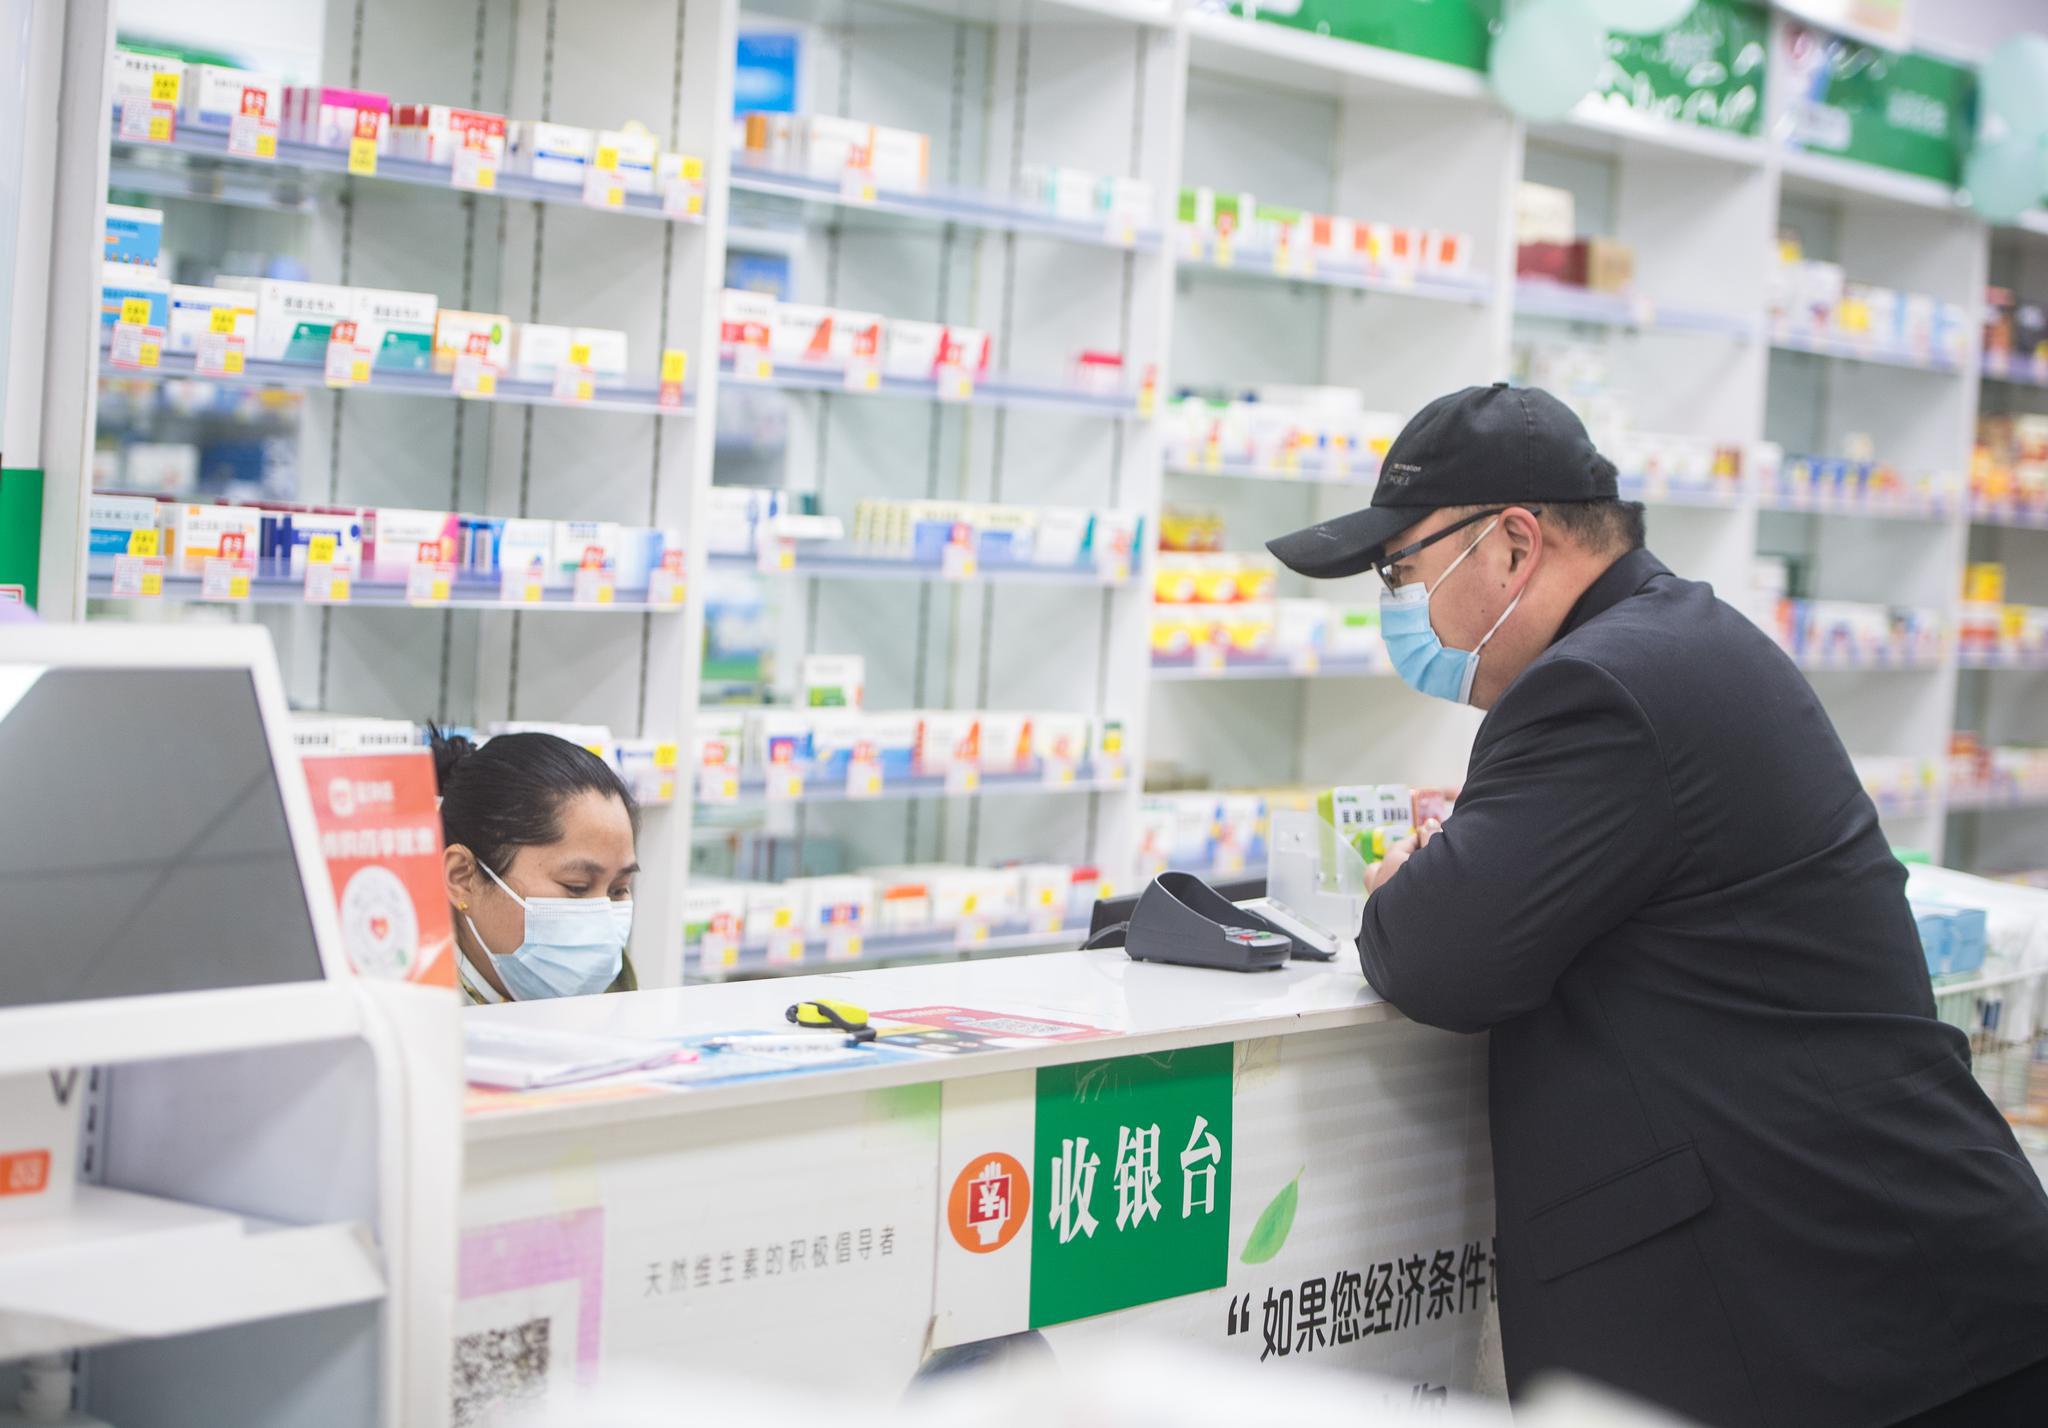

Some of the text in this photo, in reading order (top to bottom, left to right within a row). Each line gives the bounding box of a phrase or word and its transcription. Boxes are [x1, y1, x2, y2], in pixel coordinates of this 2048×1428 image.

[1049, 1115, 1222, 1244] 收银台
[643, 1225, 896, 1298] 天然维生素的积极倡导者
[1227, 1236, 1498, 1363] “如果您经济条件
